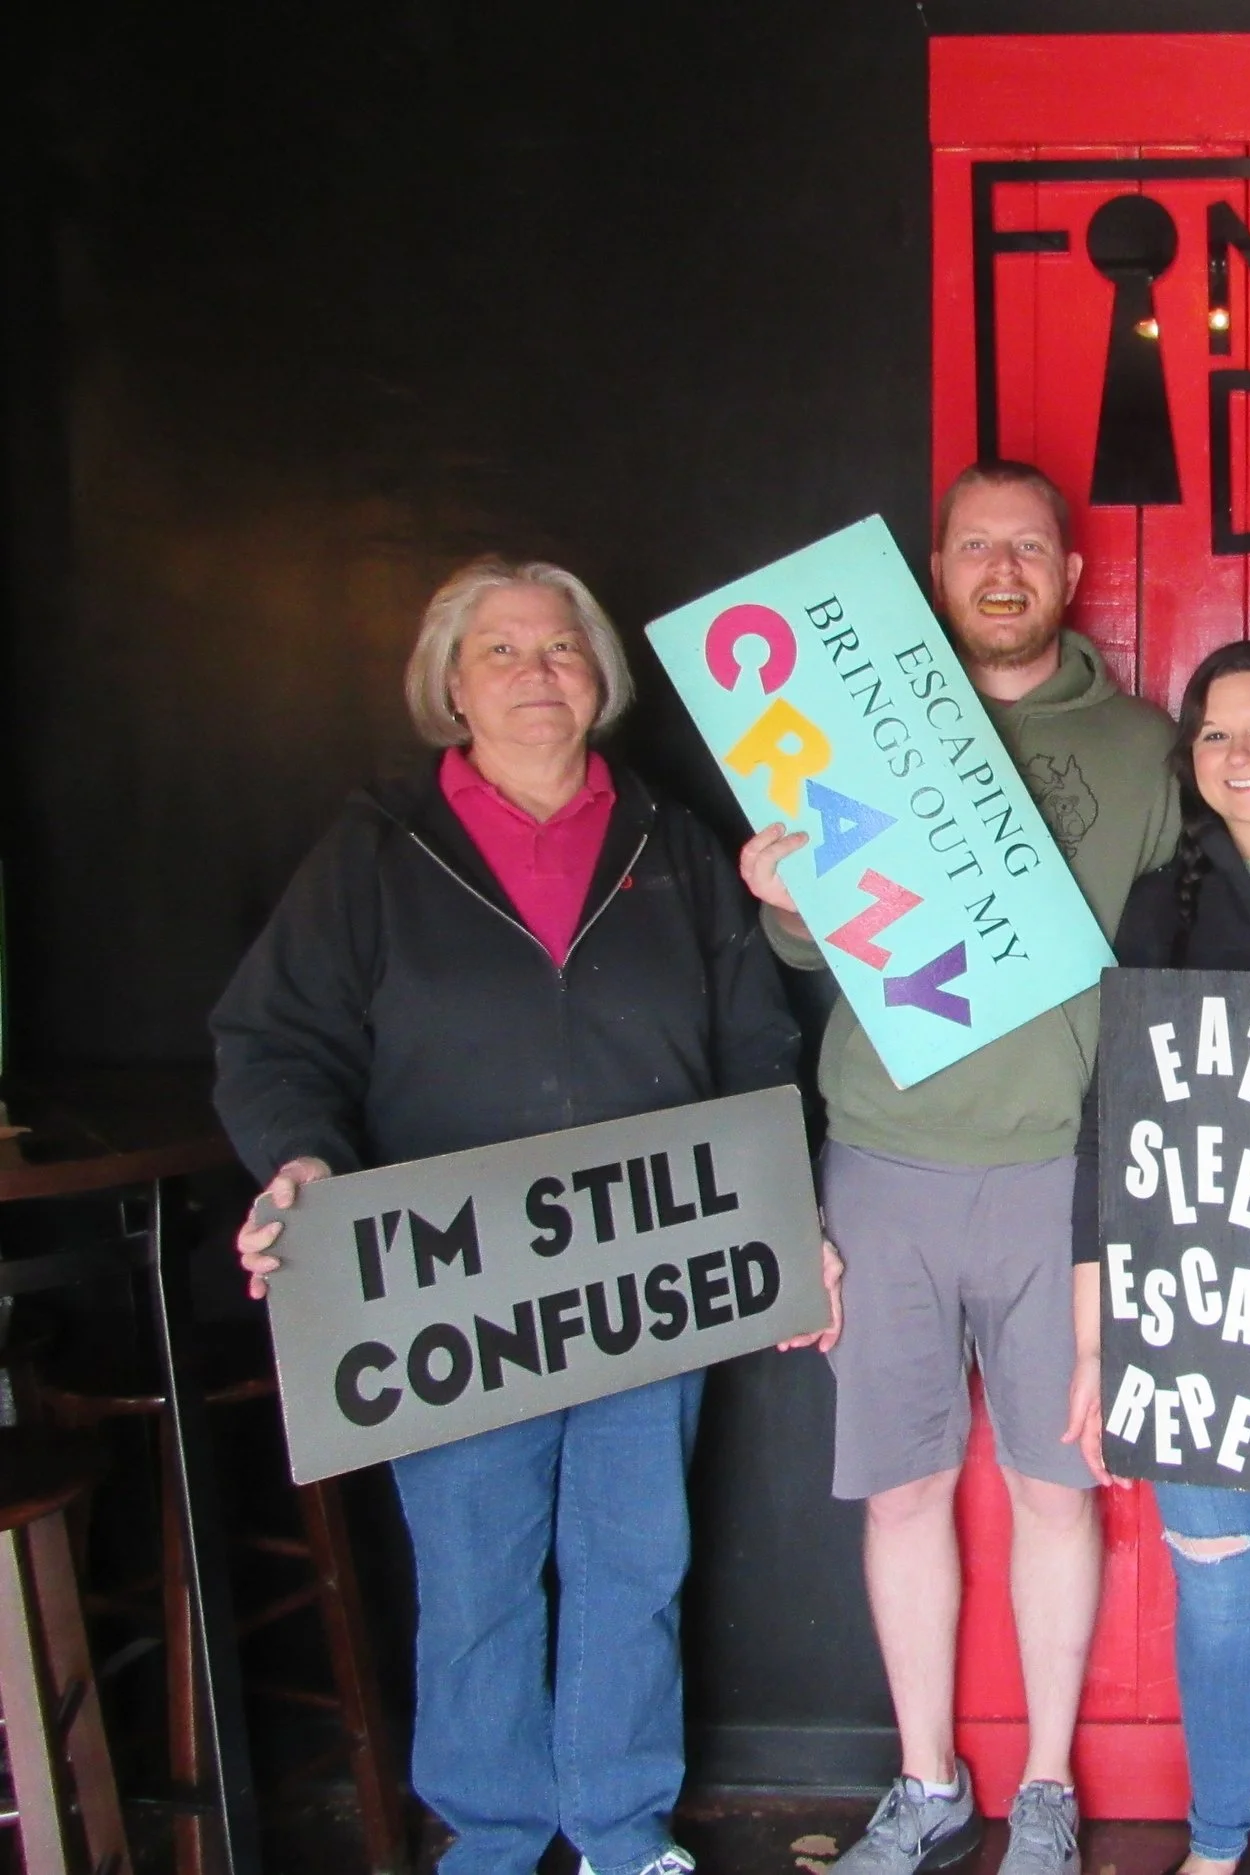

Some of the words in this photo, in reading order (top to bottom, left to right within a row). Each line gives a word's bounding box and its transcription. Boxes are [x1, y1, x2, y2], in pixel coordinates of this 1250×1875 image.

[705, 604, 973, 1028] CRAZY
[805, 593, 925, 778] BRINGS
[909, 786, 983, 881] OUT
[965, 891, 1030, 964] MY
[894, 639, 1041, 878] ESCAPING
[335, 1241, 781, 1427] CONFUSED
[353, 1195, 482, 1302] I'M
[525, 1142, 739, 1257] STILL
